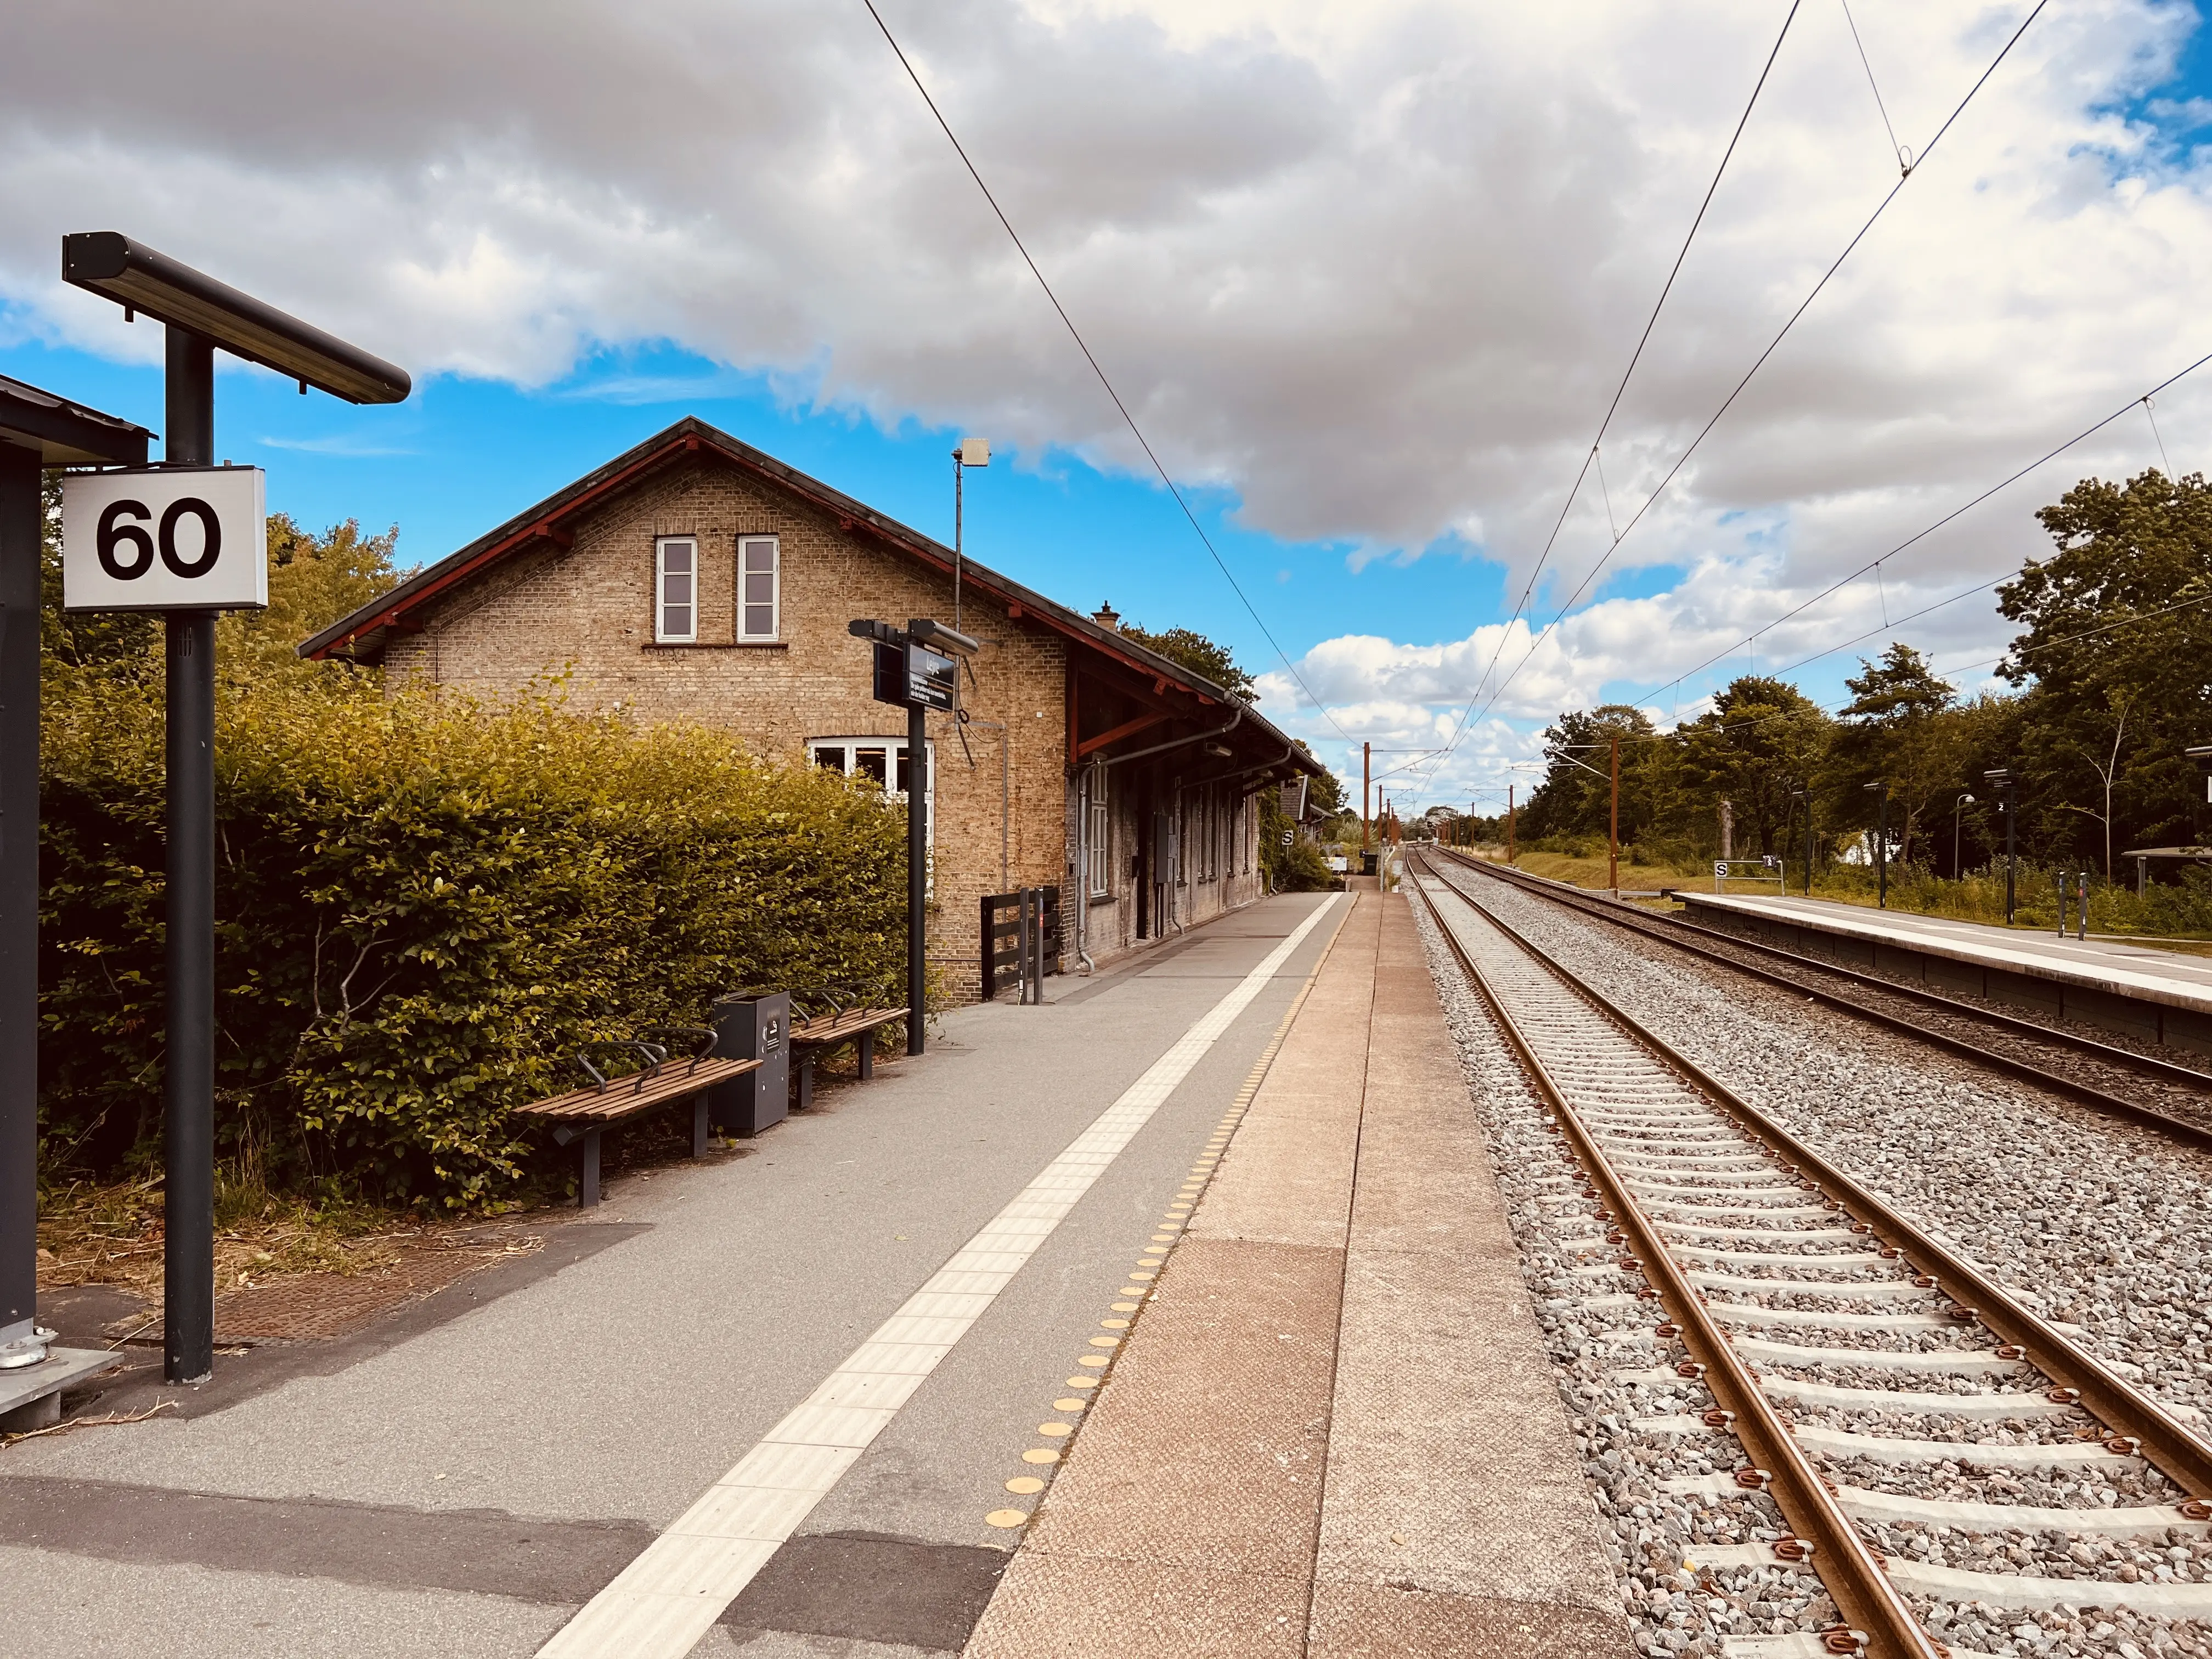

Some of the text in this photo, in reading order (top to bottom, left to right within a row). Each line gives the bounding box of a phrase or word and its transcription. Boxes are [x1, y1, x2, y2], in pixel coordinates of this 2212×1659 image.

[97, 497, 221, 580] 60
[927, 654, 940, 676] Lejre
[1283, 832, 1292, 843] S
[1717, 864, 1726, 876] S
